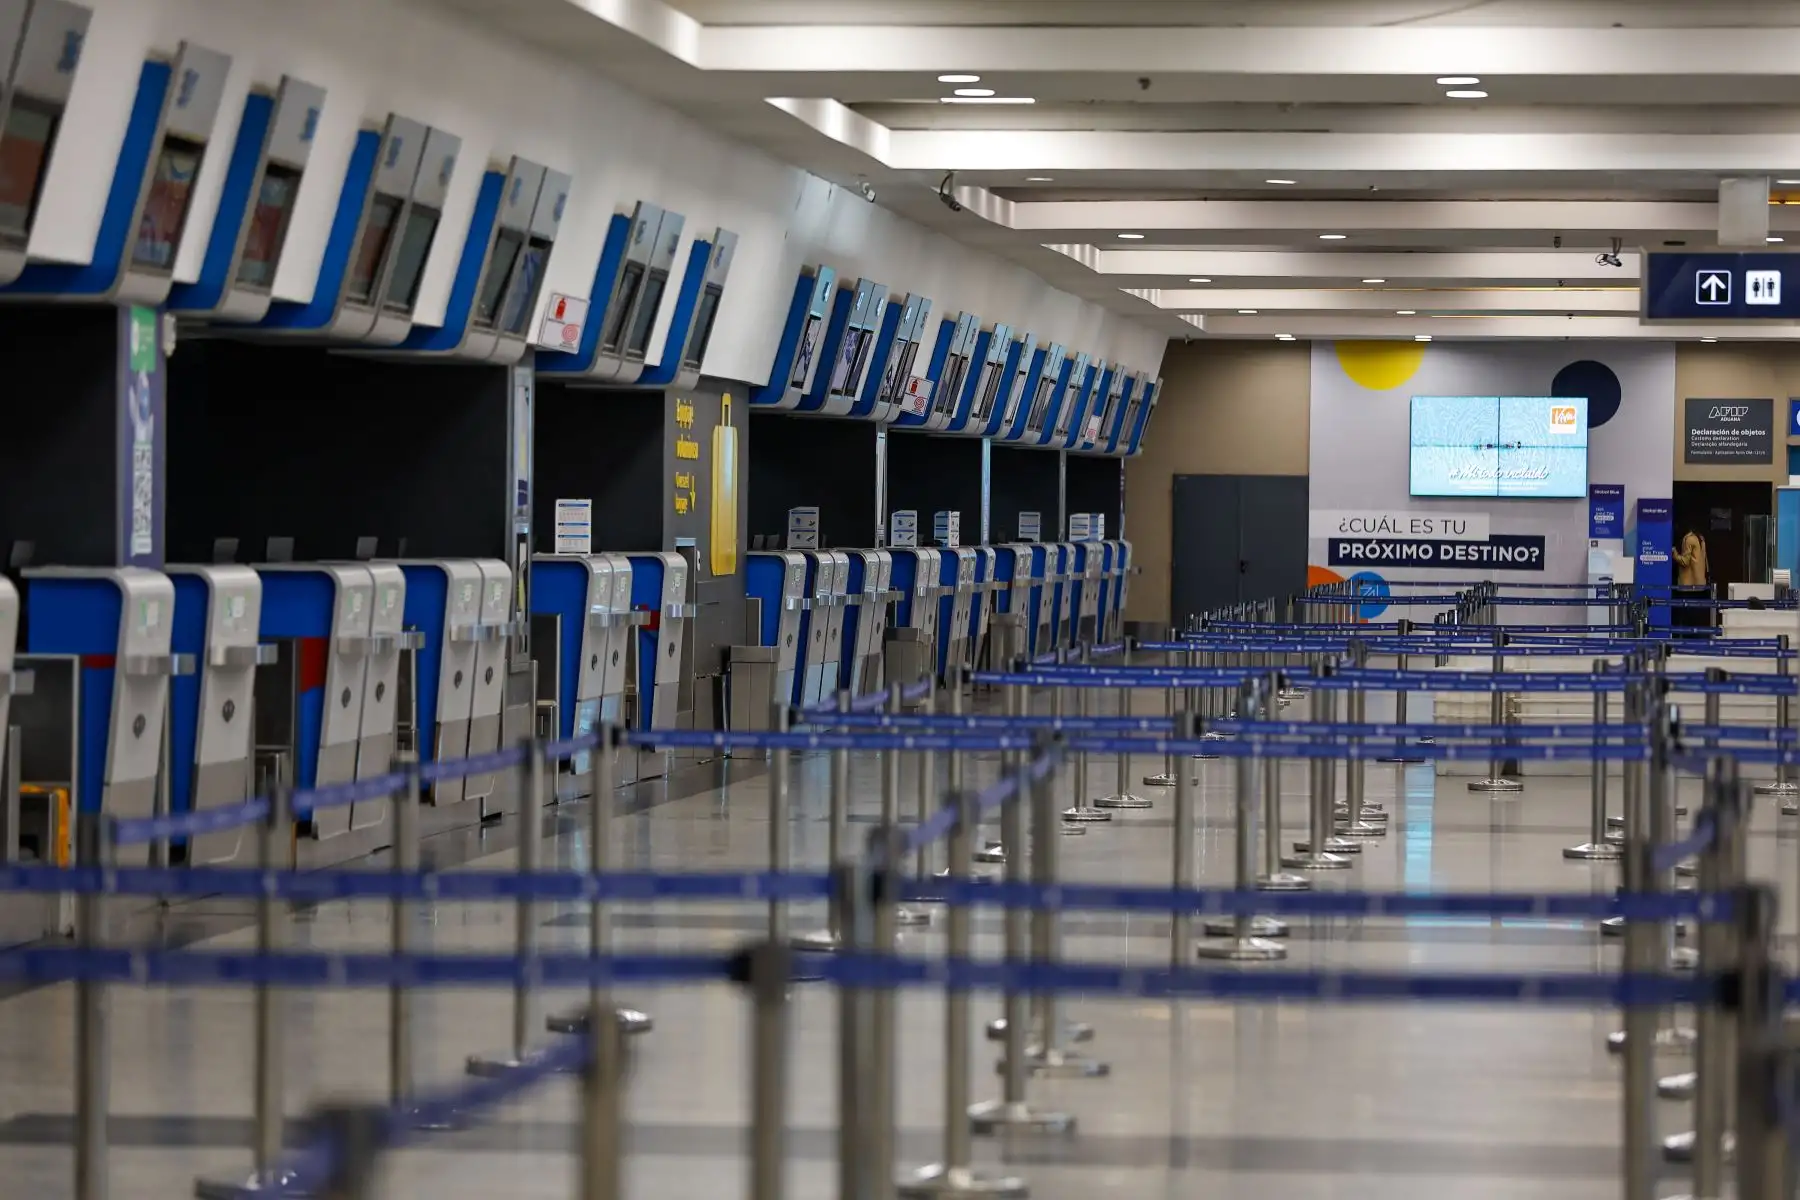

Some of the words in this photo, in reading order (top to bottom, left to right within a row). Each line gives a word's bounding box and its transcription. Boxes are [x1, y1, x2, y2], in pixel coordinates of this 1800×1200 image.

[1708, 406, 1749, 418] AFIP
[1691, 428, 1730, 436] Declaración
[1731, 428, 1740, 436] de
[1741, 428, 1766, 437] objetos
[1338, 514, 1402, 534] ¿CUÁL
[1409, 518, 1434, 534] ES
[1440, 519, 1467, 535] TU
[1338, 540, 1433, 560] PRÓXIMO
[1440, 544, 1540, 562] DESTINO?
